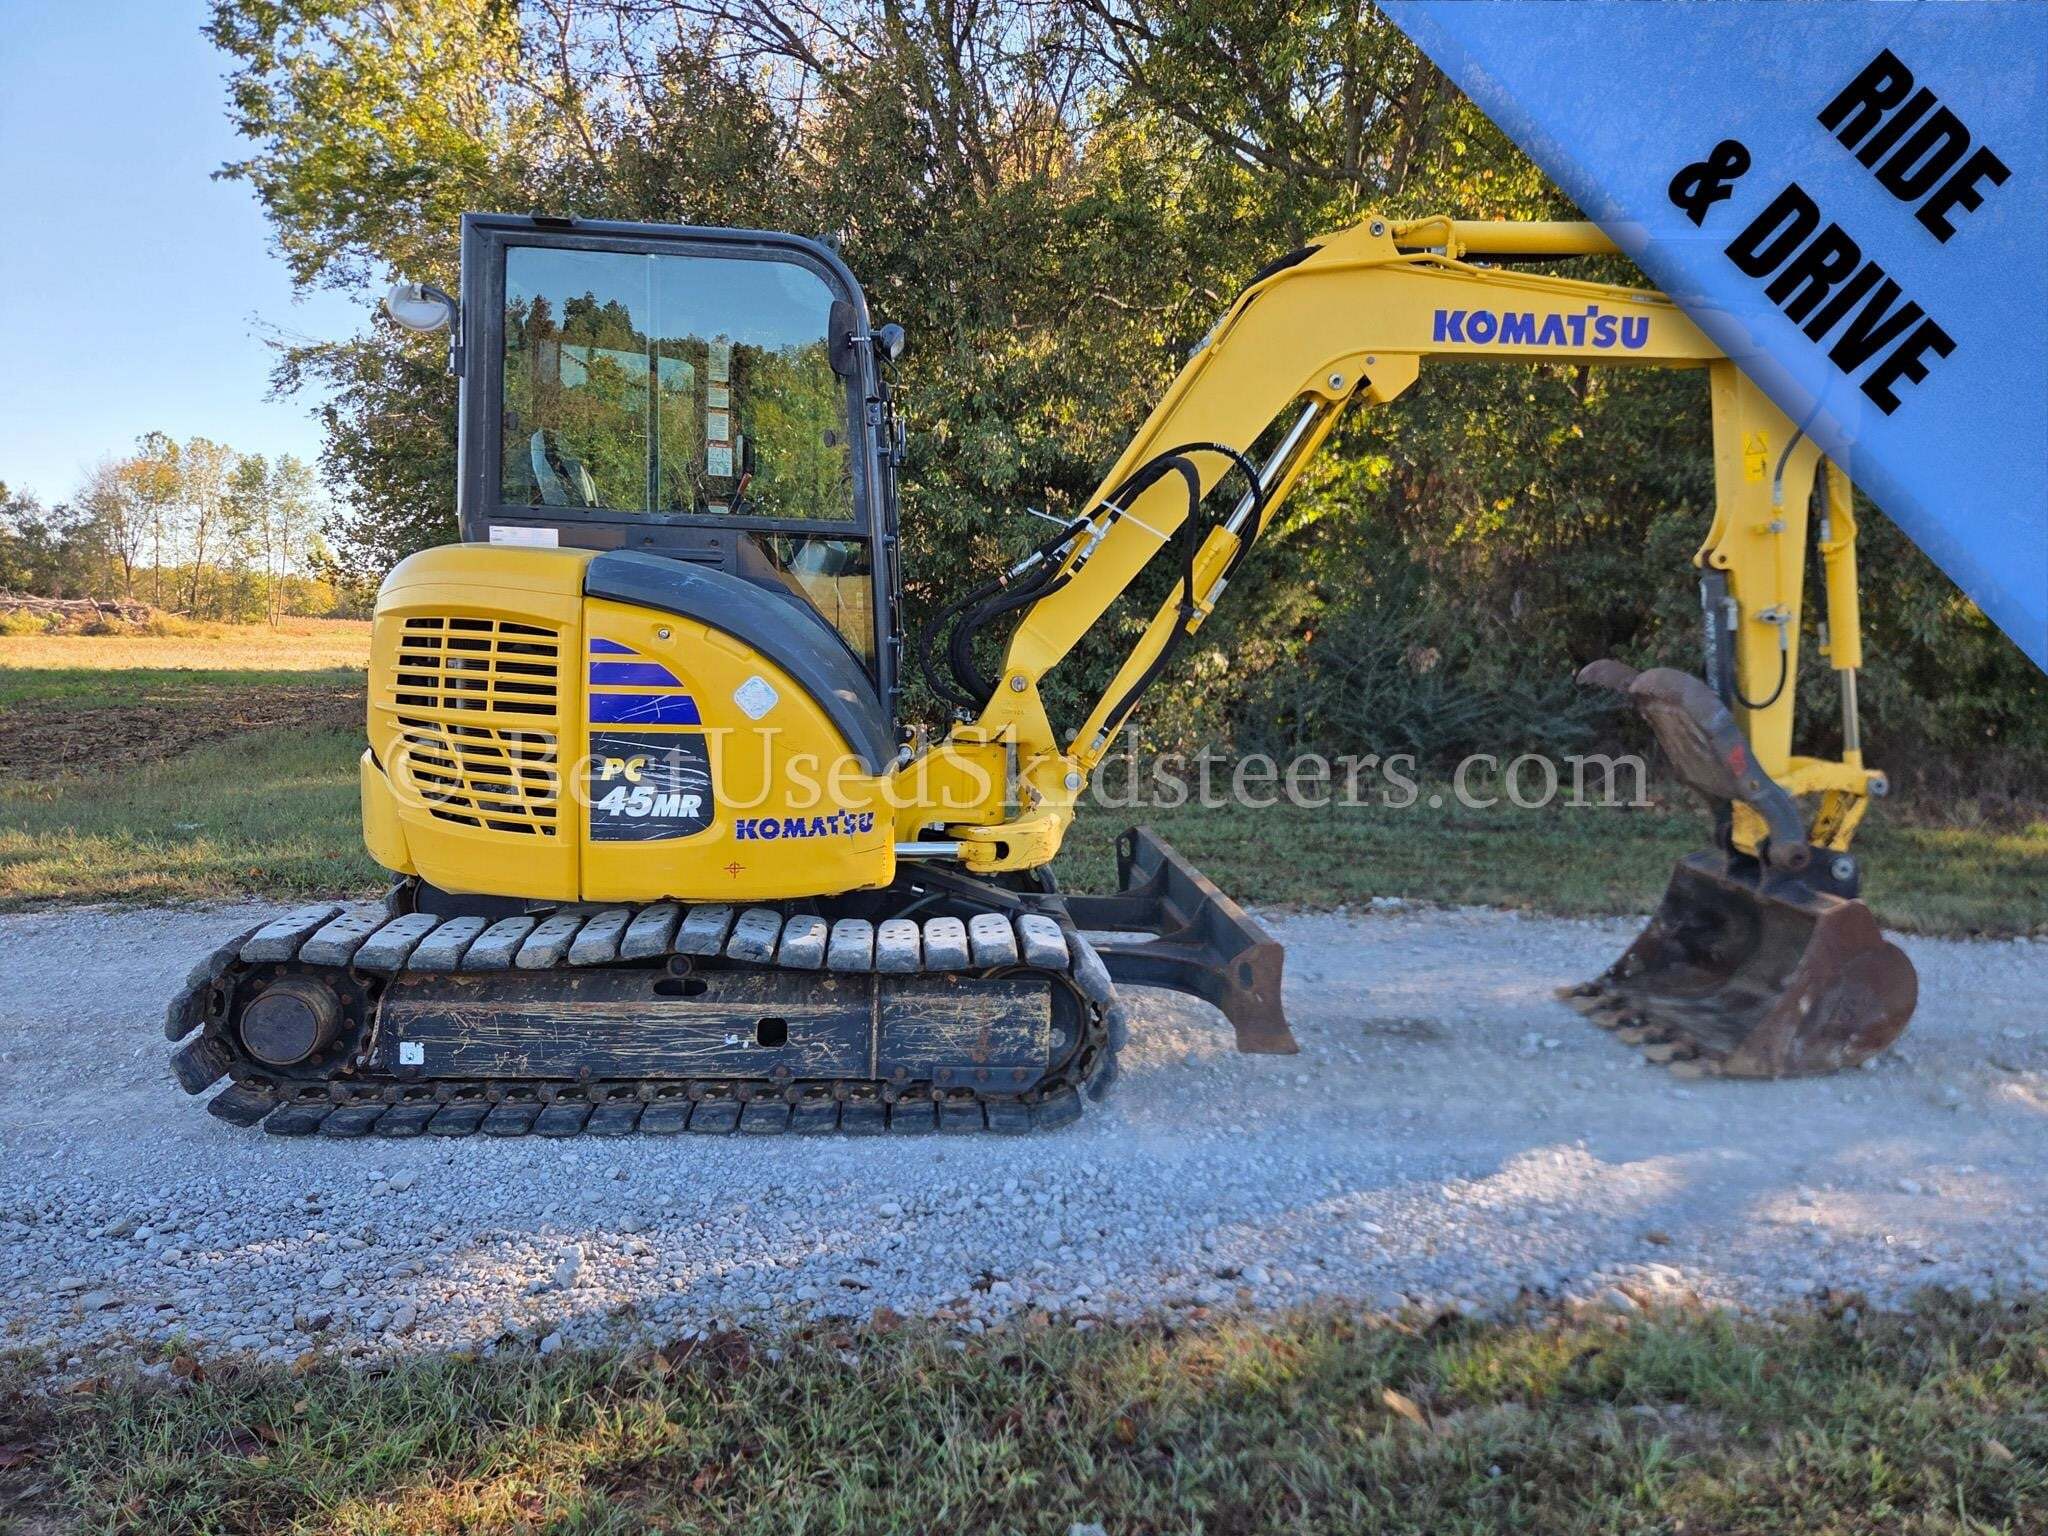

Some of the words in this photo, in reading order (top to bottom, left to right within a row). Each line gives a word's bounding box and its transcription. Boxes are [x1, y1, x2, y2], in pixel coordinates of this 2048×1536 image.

[1433, 305, 1650, 349] KOMATSU
[600, 757, 646, 782] PC
[597, 786, 703, 818] 45MR
[736, 808, 875, 840] KOMATSU
